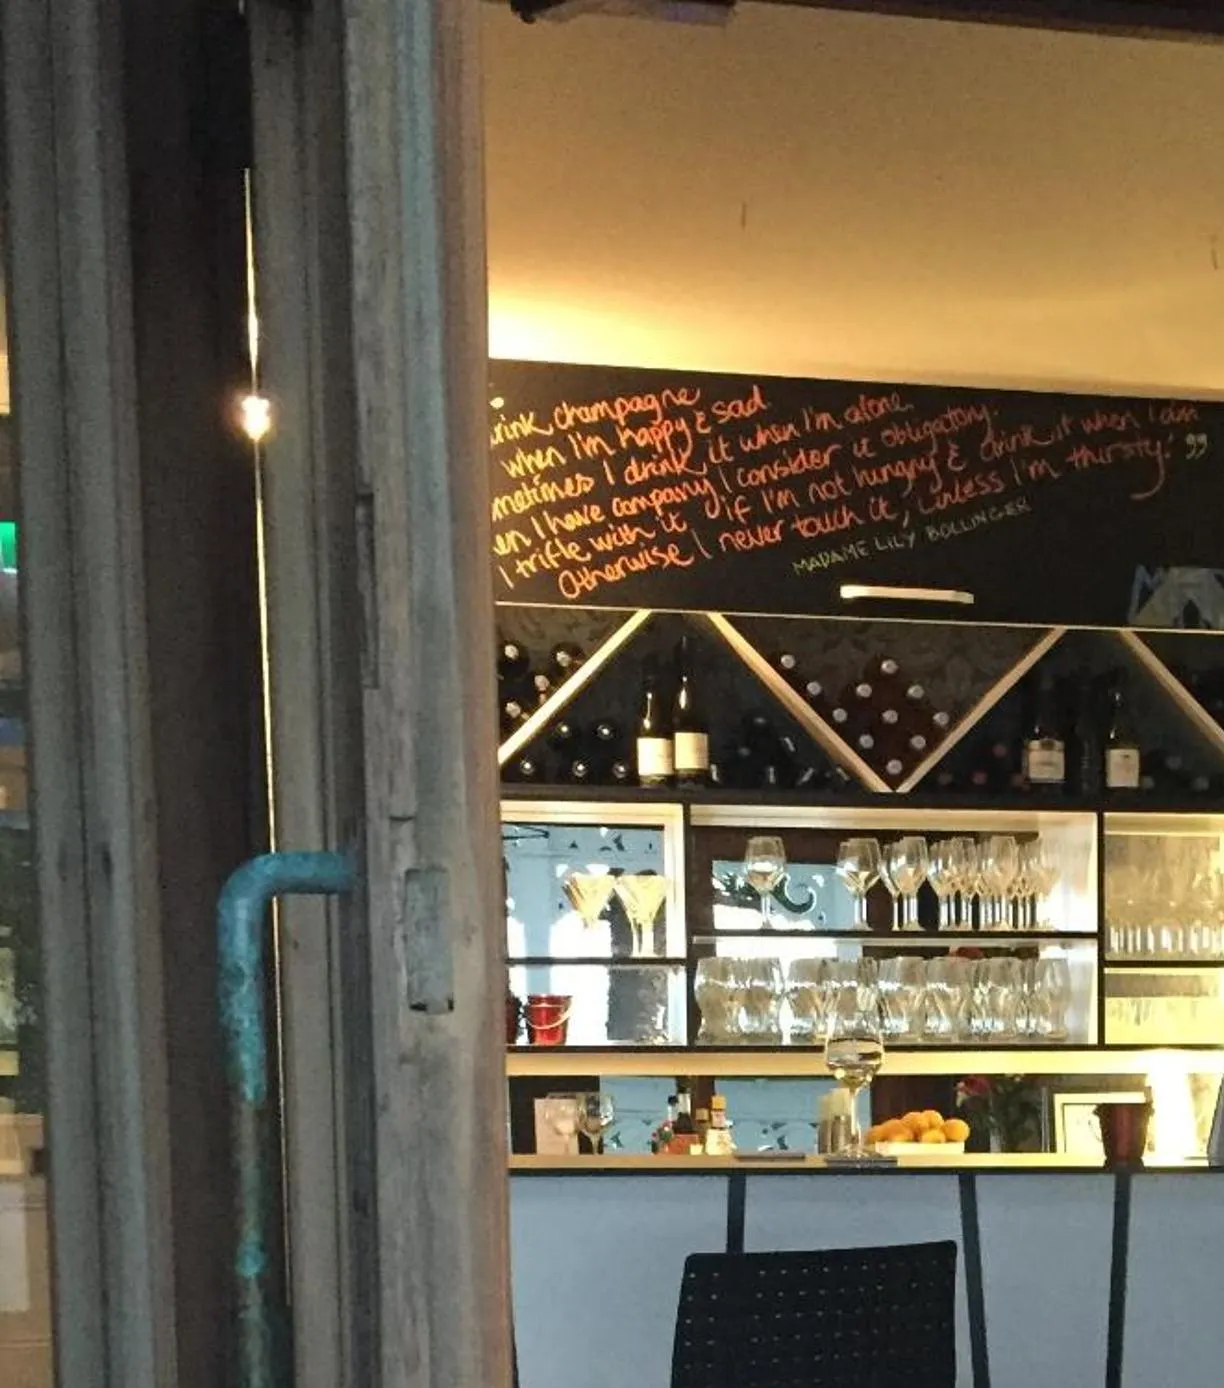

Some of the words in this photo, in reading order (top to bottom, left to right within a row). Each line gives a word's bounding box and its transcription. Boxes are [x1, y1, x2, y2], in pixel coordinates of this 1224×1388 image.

[490, 411, 553, 448] rink
[555, 387, 700, 430] champagne
[492, 472, 594, 522] metimes
[603, 460, 615, 485] I
[624, 456, 707, 485] drink
[709, 436, 734, 463] it
[740, 424, 800, 453] when
[802, 405, 843, 432] I'm
[501, 447, 566, 478] when
[568, 432, 616, 460] I'm
[616, 417, 693, 462] happy
[493, 529, 531, 556] en
[531, 516, 545, 539] I
[543, 504, 605, 534] have
[612, 478, 720, 518] company
[717, 461, 732, 493] I
[737, 444, 842, 487] consider
[853, 437, 876, 458] it
[515, 537, 592, 578] trifle
[589, 524, 656, 551] with
[655, 512, 687, 532] it
[720, 495, 752, 524] if
[761, 488, 800, 513] I'm
[808, 471, 852, 503] not
[852, 454, 942, 497] hungry
[980, 424, 1054, 462] drink
[1056, 413, 1072, 441] it
[1080, 409, 1141, 434] when
[558, 543, 694, 599] Otherwise
[691, 528, 713, 559] I
[718, 519, 784, 552] never
[791, 504, 864, 538] touch
[1009, 456, 1062, 486] I'm
[792, 540, 870, 575] MADAME
[925, 497, 1032, 541] BOLLINGER
